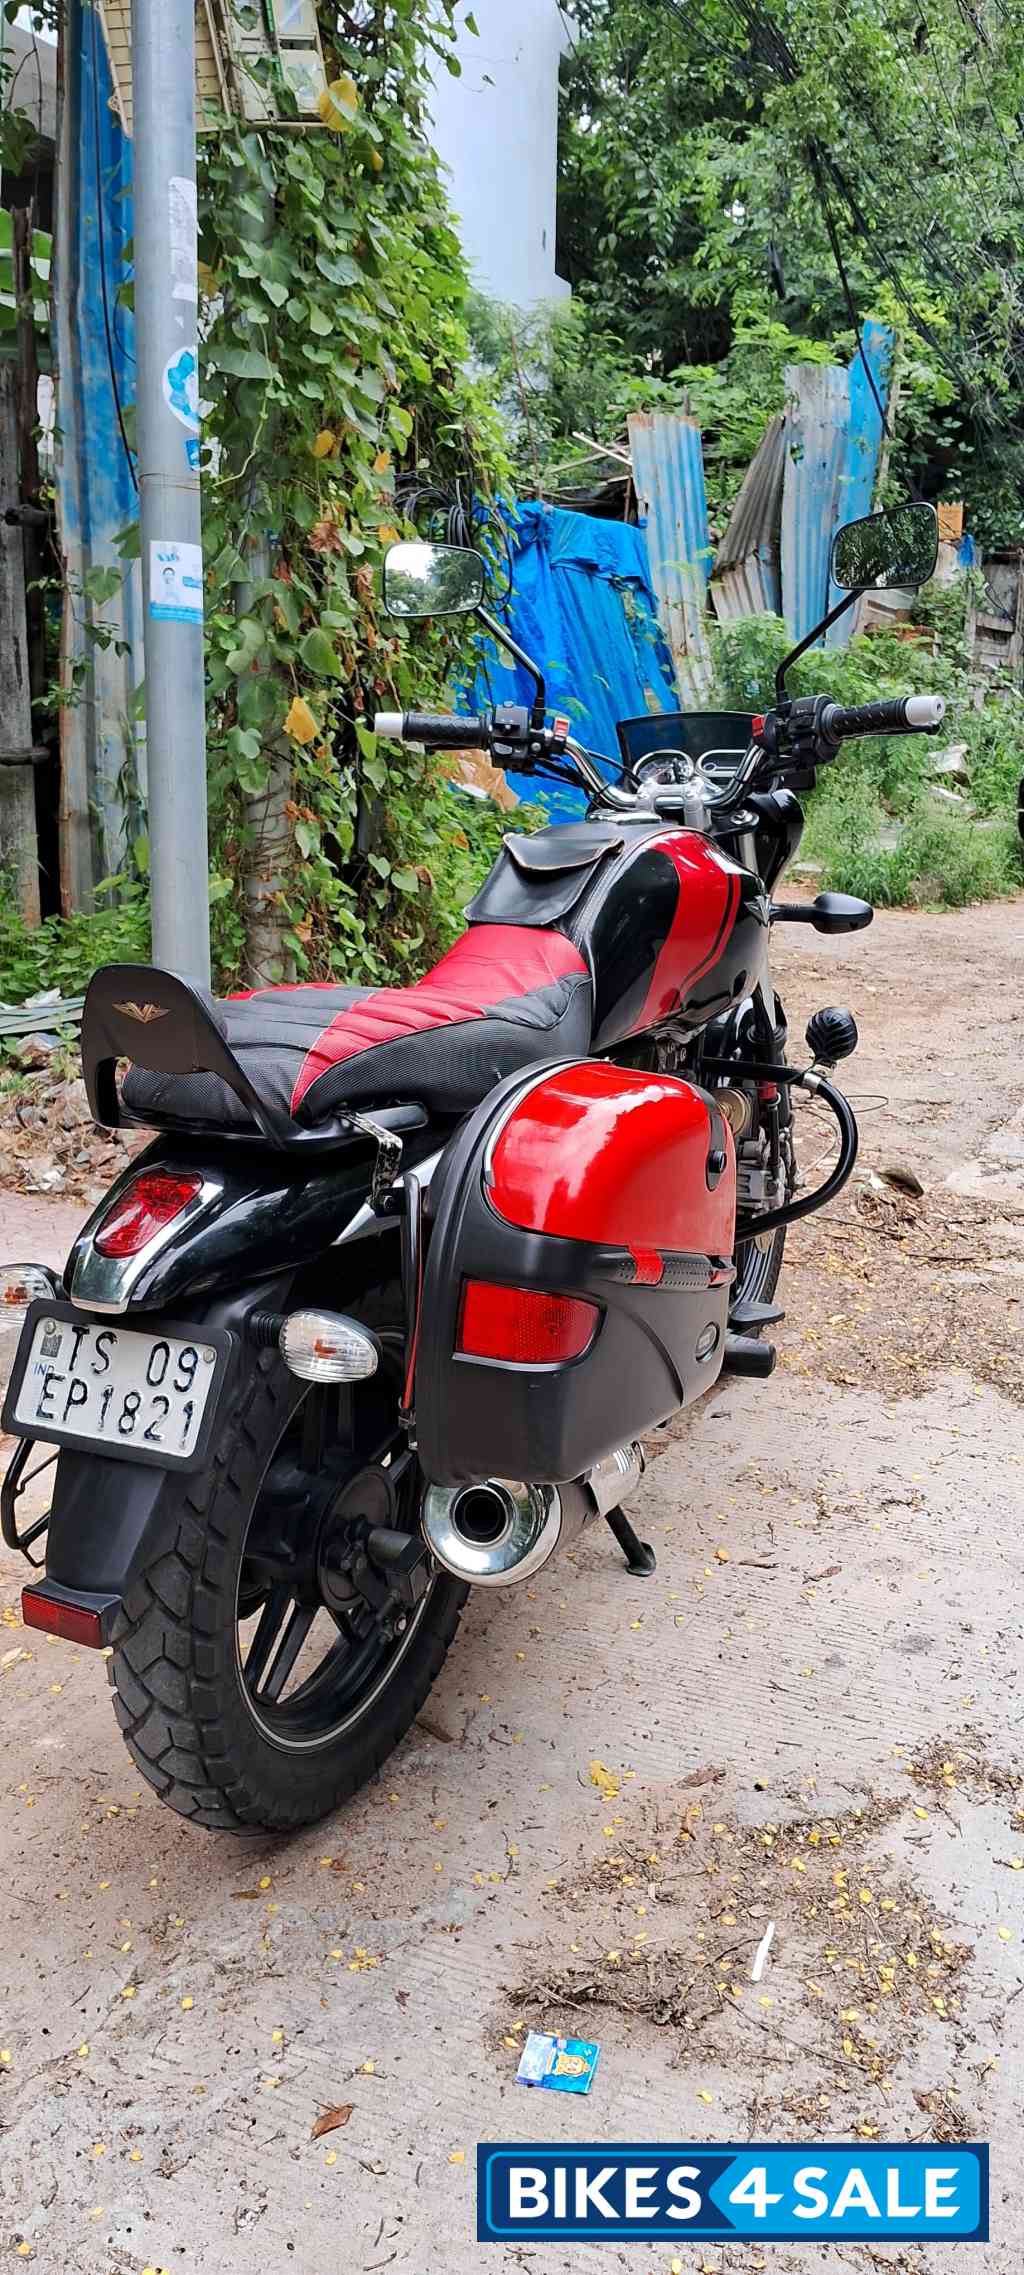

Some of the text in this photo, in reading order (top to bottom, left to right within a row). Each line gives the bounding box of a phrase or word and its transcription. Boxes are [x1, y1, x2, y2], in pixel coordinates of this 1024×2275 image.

[69, 1325, 199, 1393] TS 09
[35, 1371, 195, 1450] EP1821
